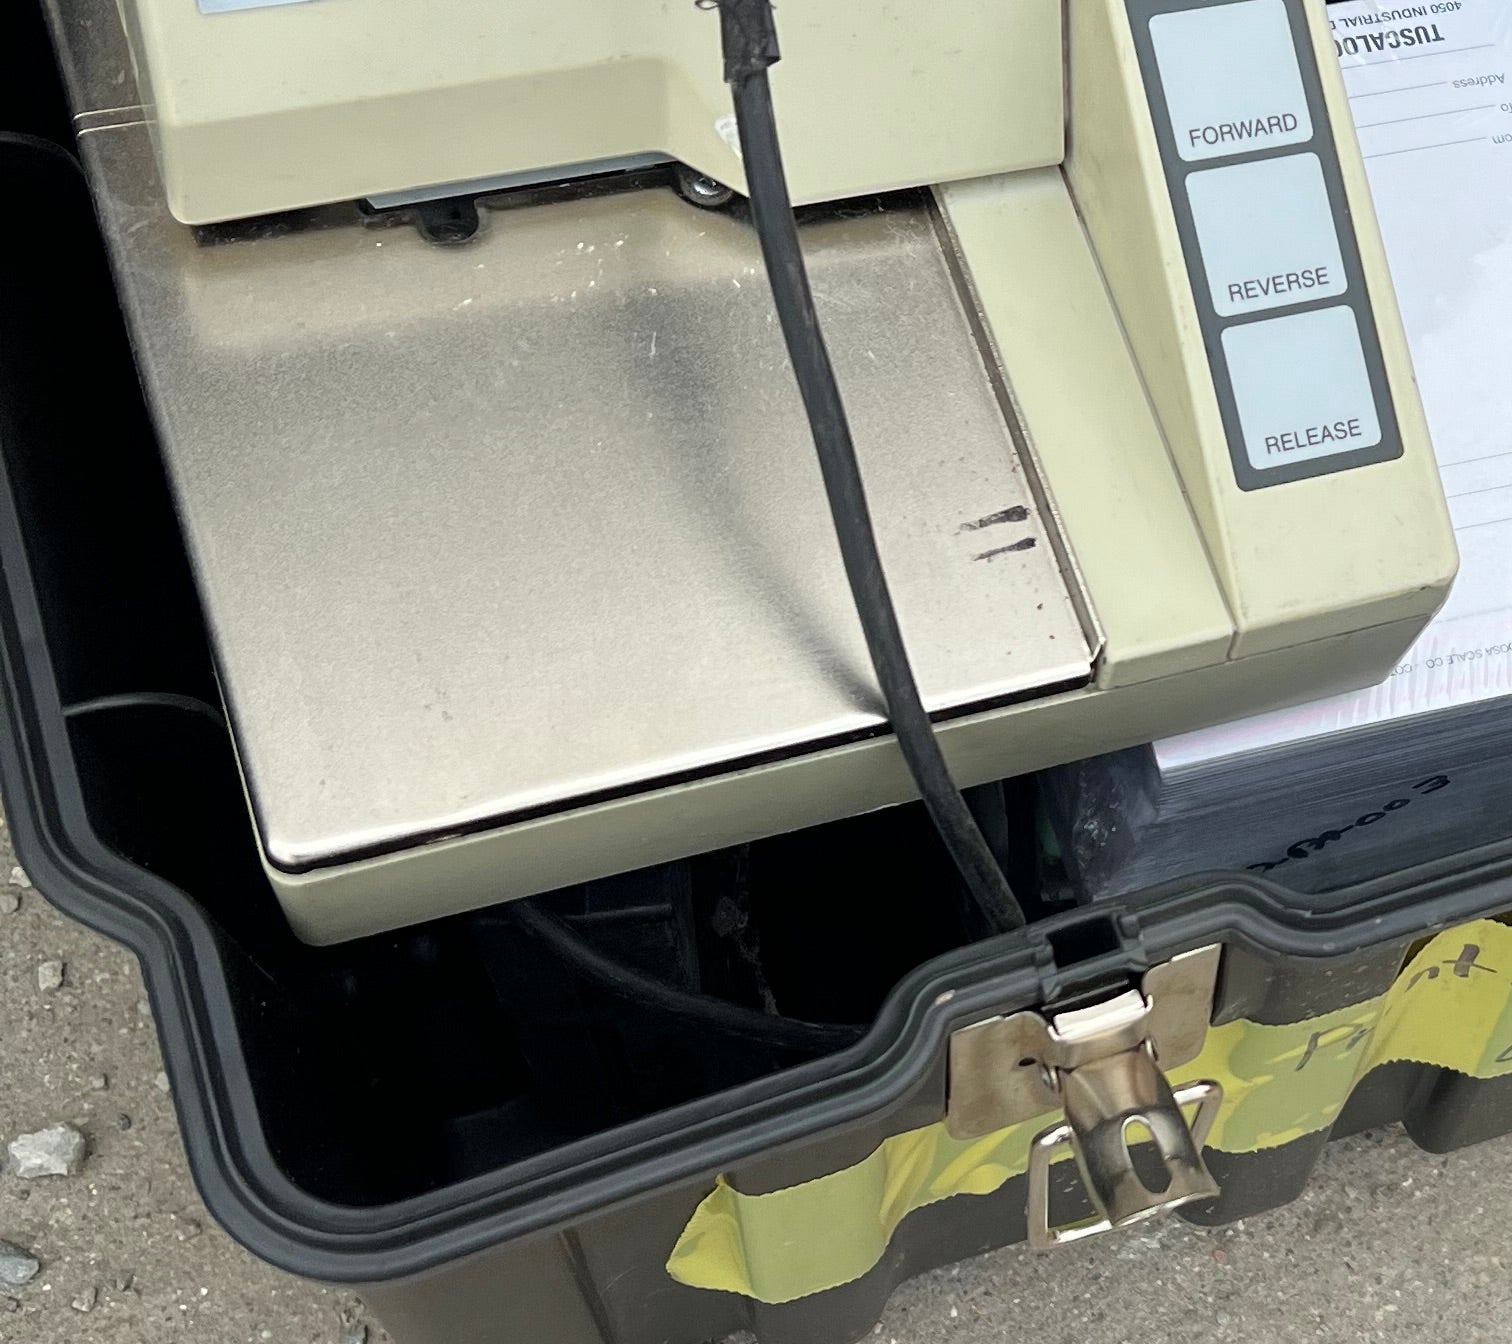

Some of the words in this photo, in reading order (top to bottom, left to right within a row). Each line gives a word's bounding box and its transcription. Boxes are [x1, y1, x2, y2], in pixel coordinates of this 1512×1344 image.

[1339, 6, 1428, 29] INDUSTRIAL
[1429, 0, 1463, 16] 4050
[1451, 71, 1506, 90] Address
[1188, 111, 1299, 148] FORWARD
[1226, 266, 1330, 303] REVERSE
[1265, 417, 1363, 457] RELEASE
[1445, 647, 1482, 665] SCALE
